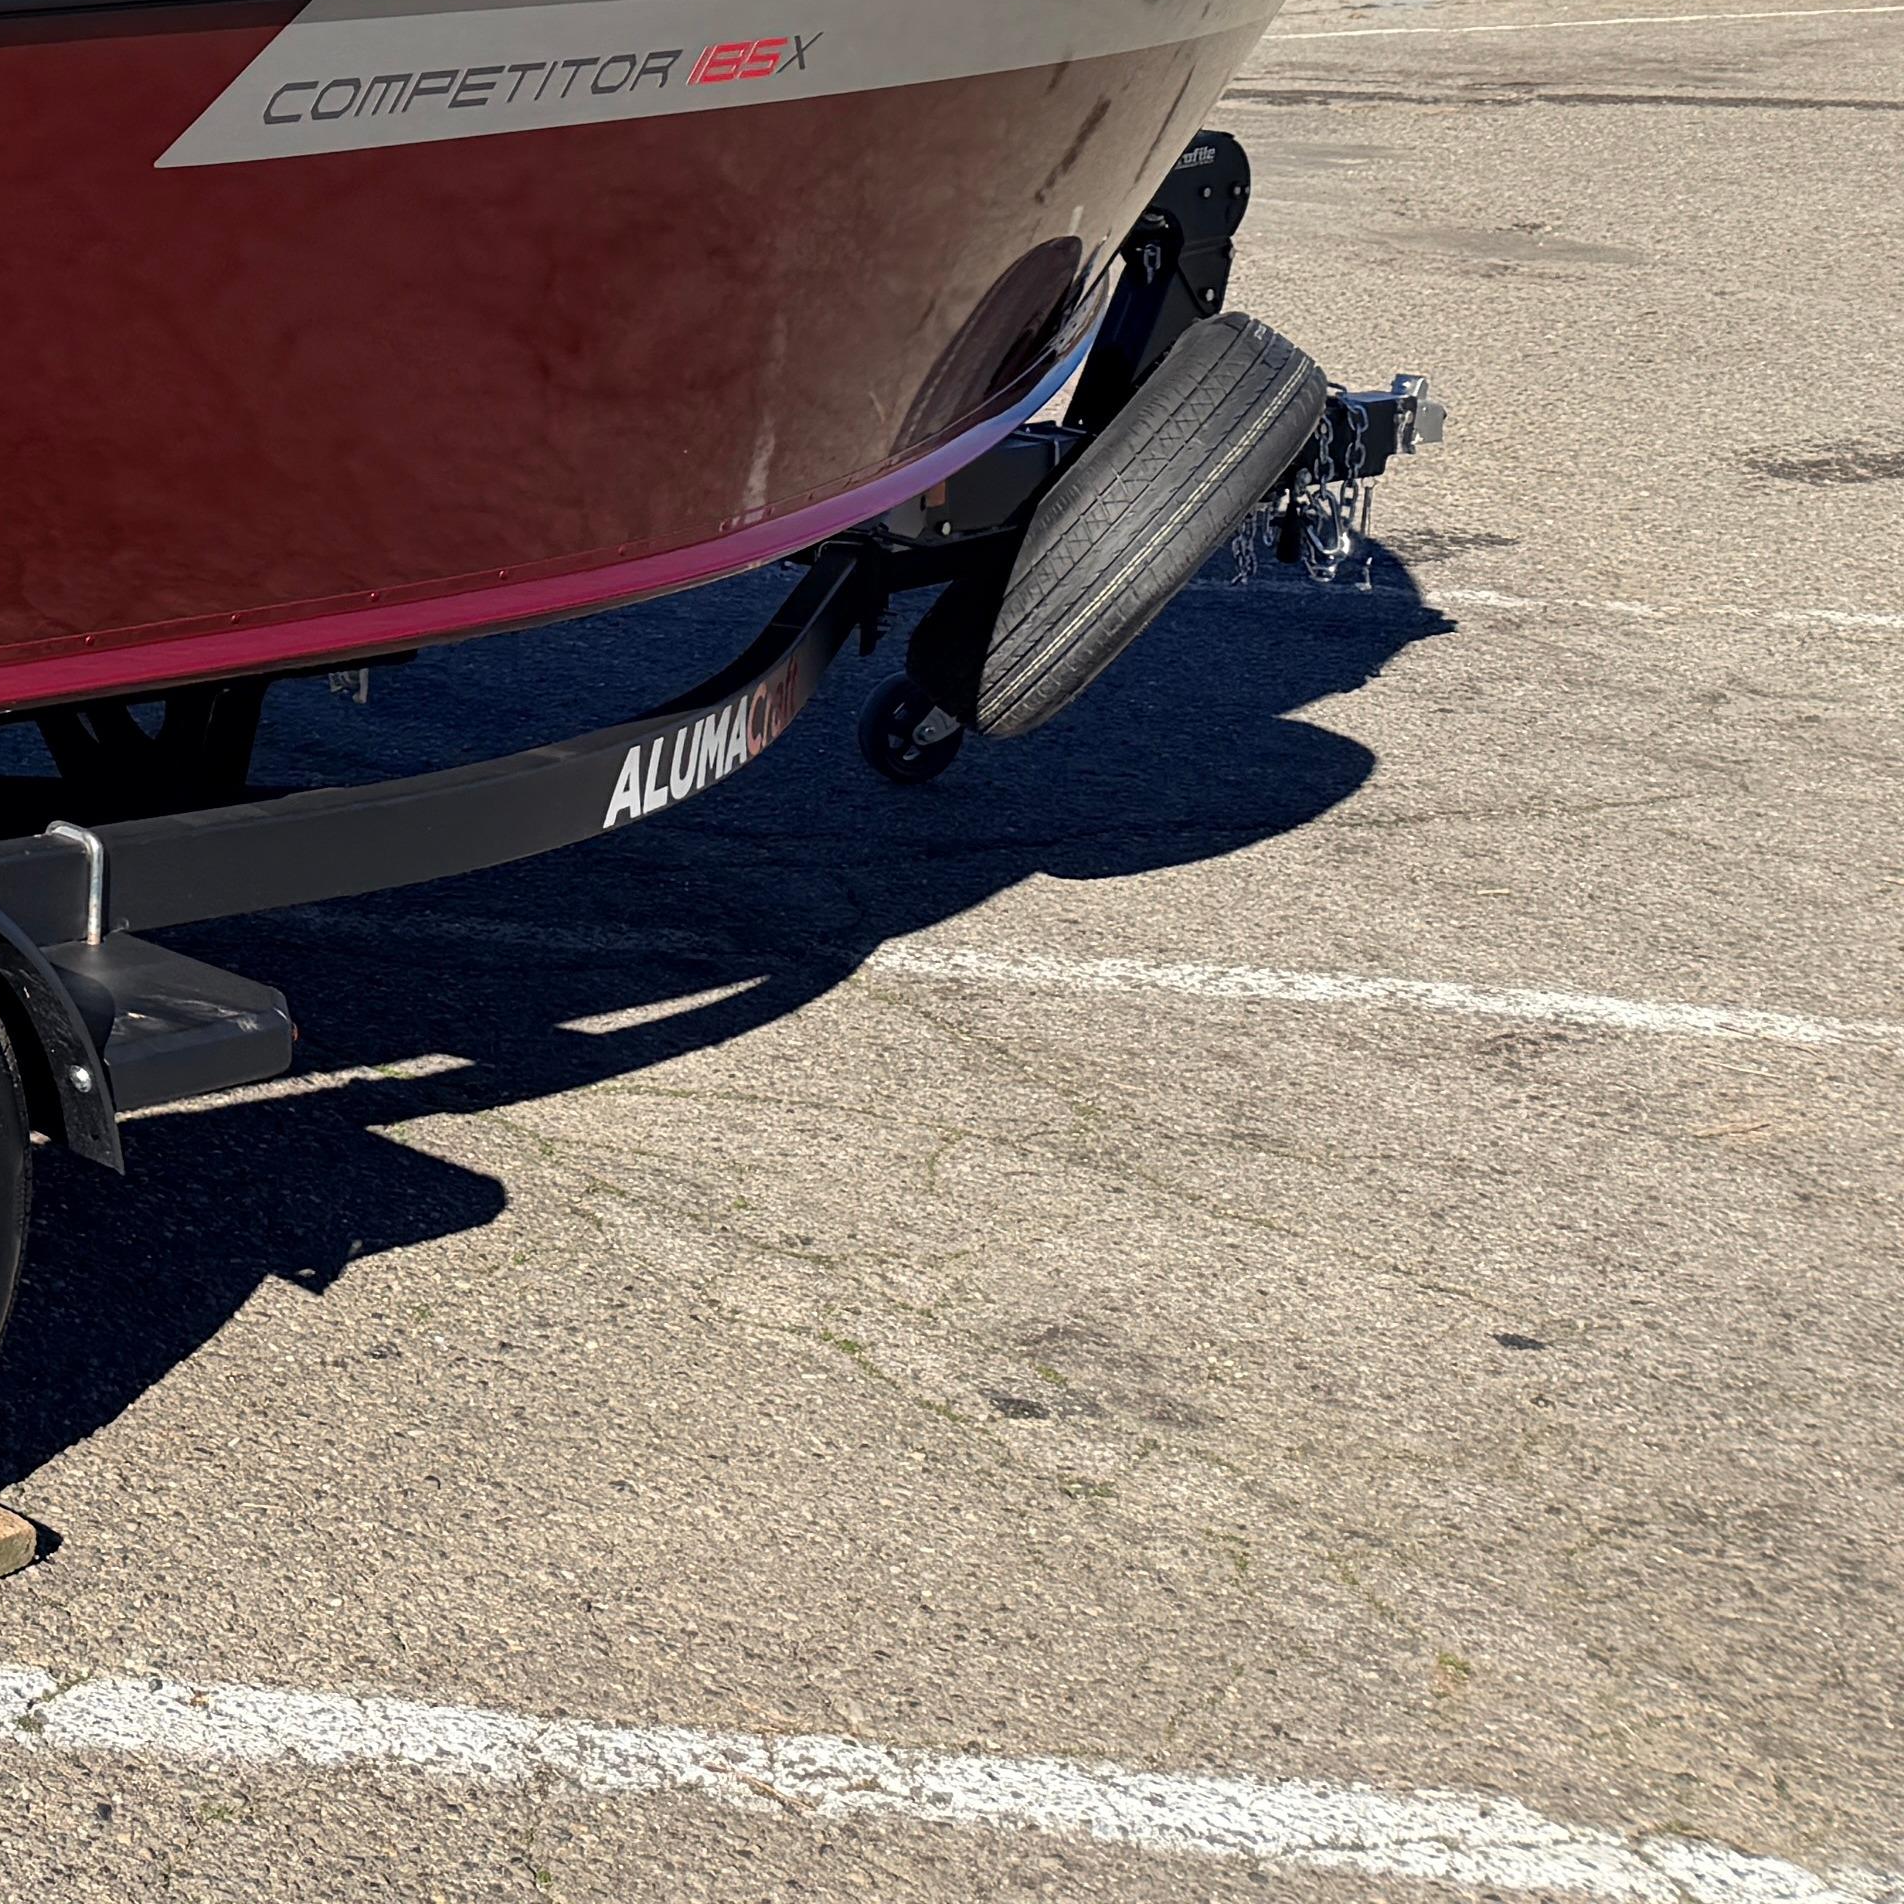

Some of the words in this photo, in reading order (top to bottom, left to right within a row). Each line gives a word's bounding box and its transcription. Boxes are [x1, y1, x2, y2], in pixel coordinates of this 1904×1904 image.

[263, 49, 683, 125] COMPETITOR
[686, 31, 824, 87] 185X
[1177, 146, 1216, 164] rofile
